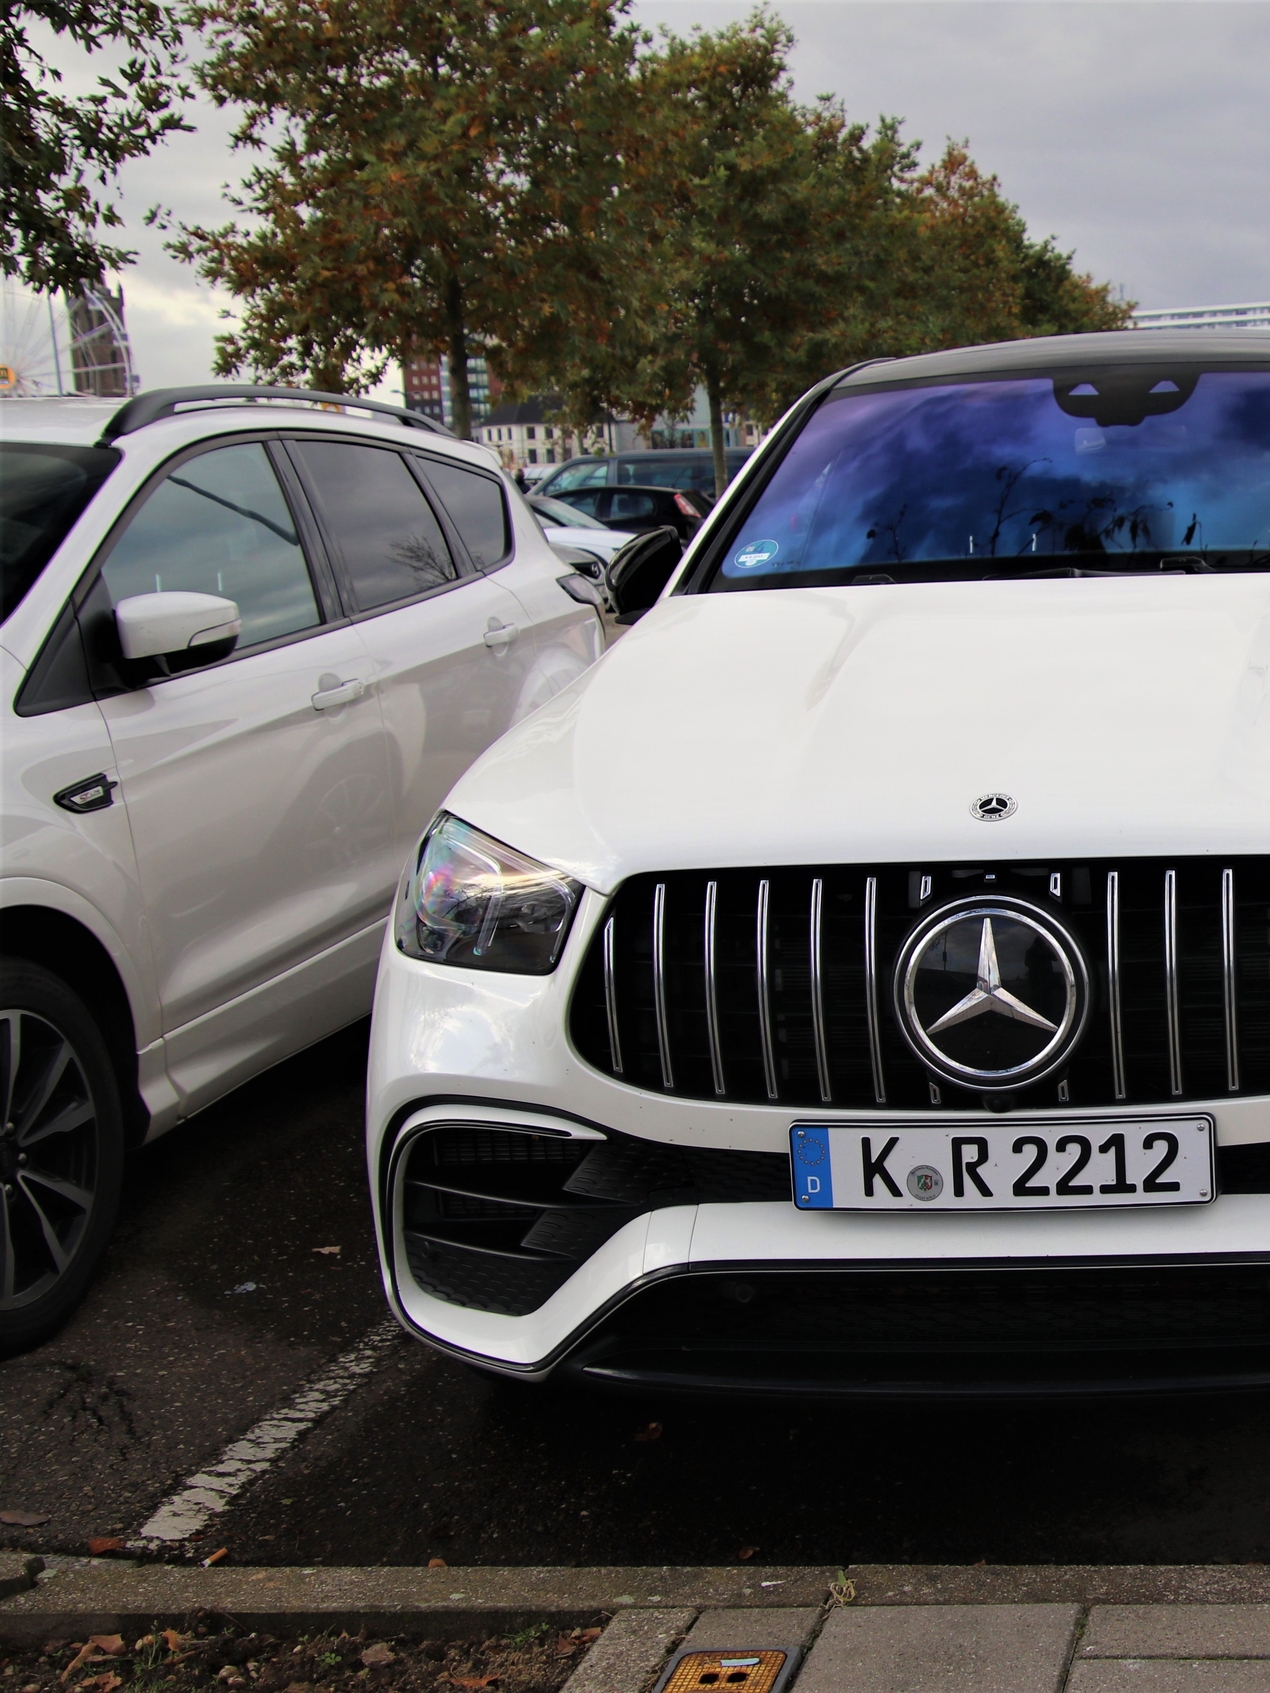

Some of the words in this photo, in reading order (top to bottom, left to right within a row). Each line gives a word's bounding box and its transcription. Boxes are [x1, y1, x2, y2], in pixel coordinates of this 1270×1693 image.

[807, 1176, 821, 1193] D
[861, 1136, 903, 1198] K
[951, 1136, 994, 1198] R
[1012, 1131, 1181, 1197] 2212
